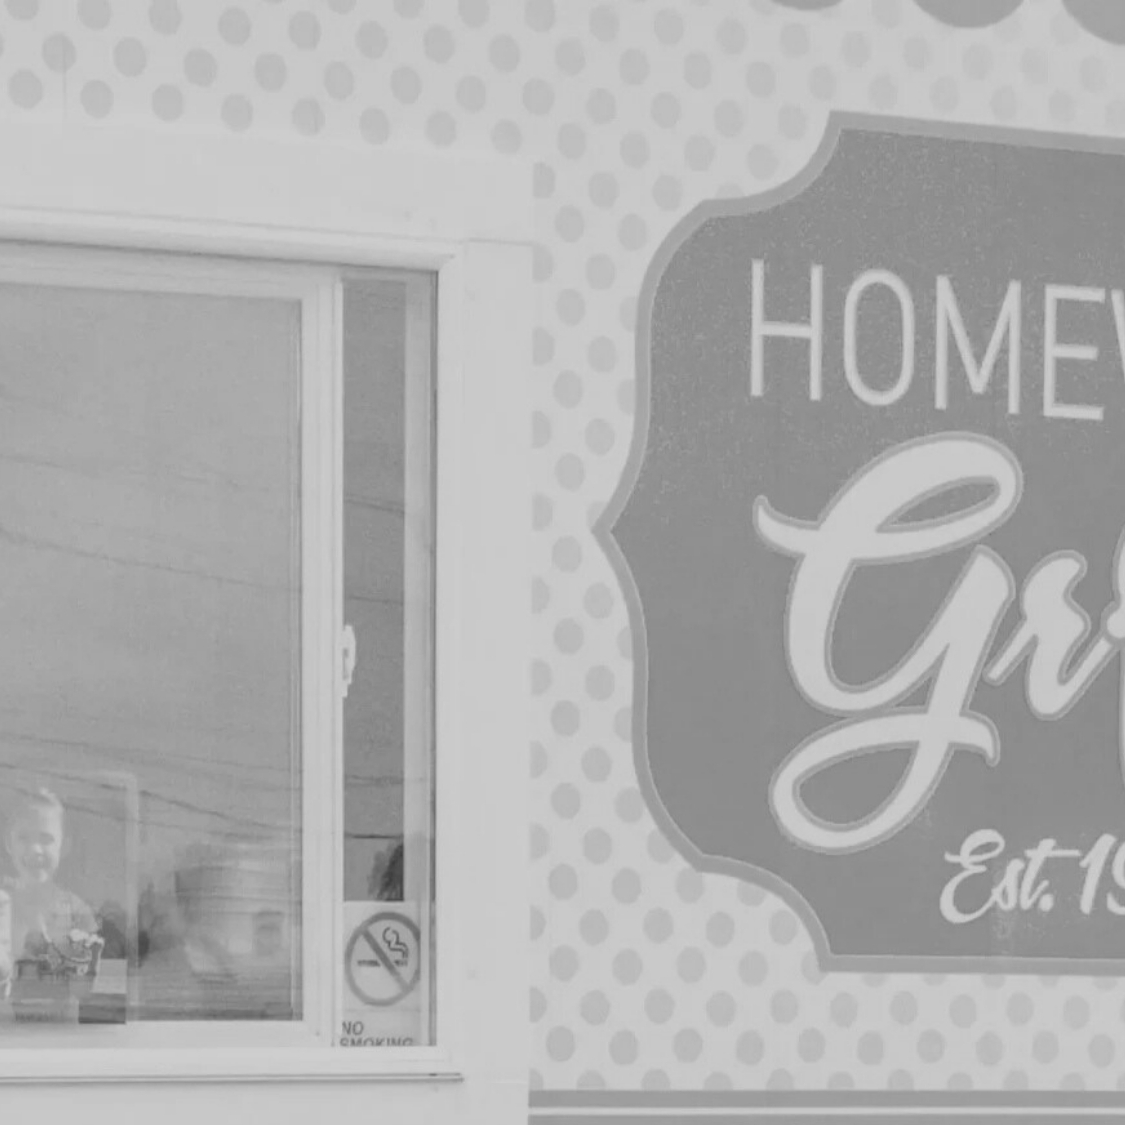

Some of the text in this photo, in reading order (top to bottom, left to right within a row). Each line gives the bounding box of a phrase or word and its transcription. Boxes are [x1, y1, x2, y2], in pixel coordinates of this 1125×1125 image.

[753, 431, 1125, 856] Gr
[939, 828, 1081, 924] Est.
[341, 1020, 365, 1036] NO
